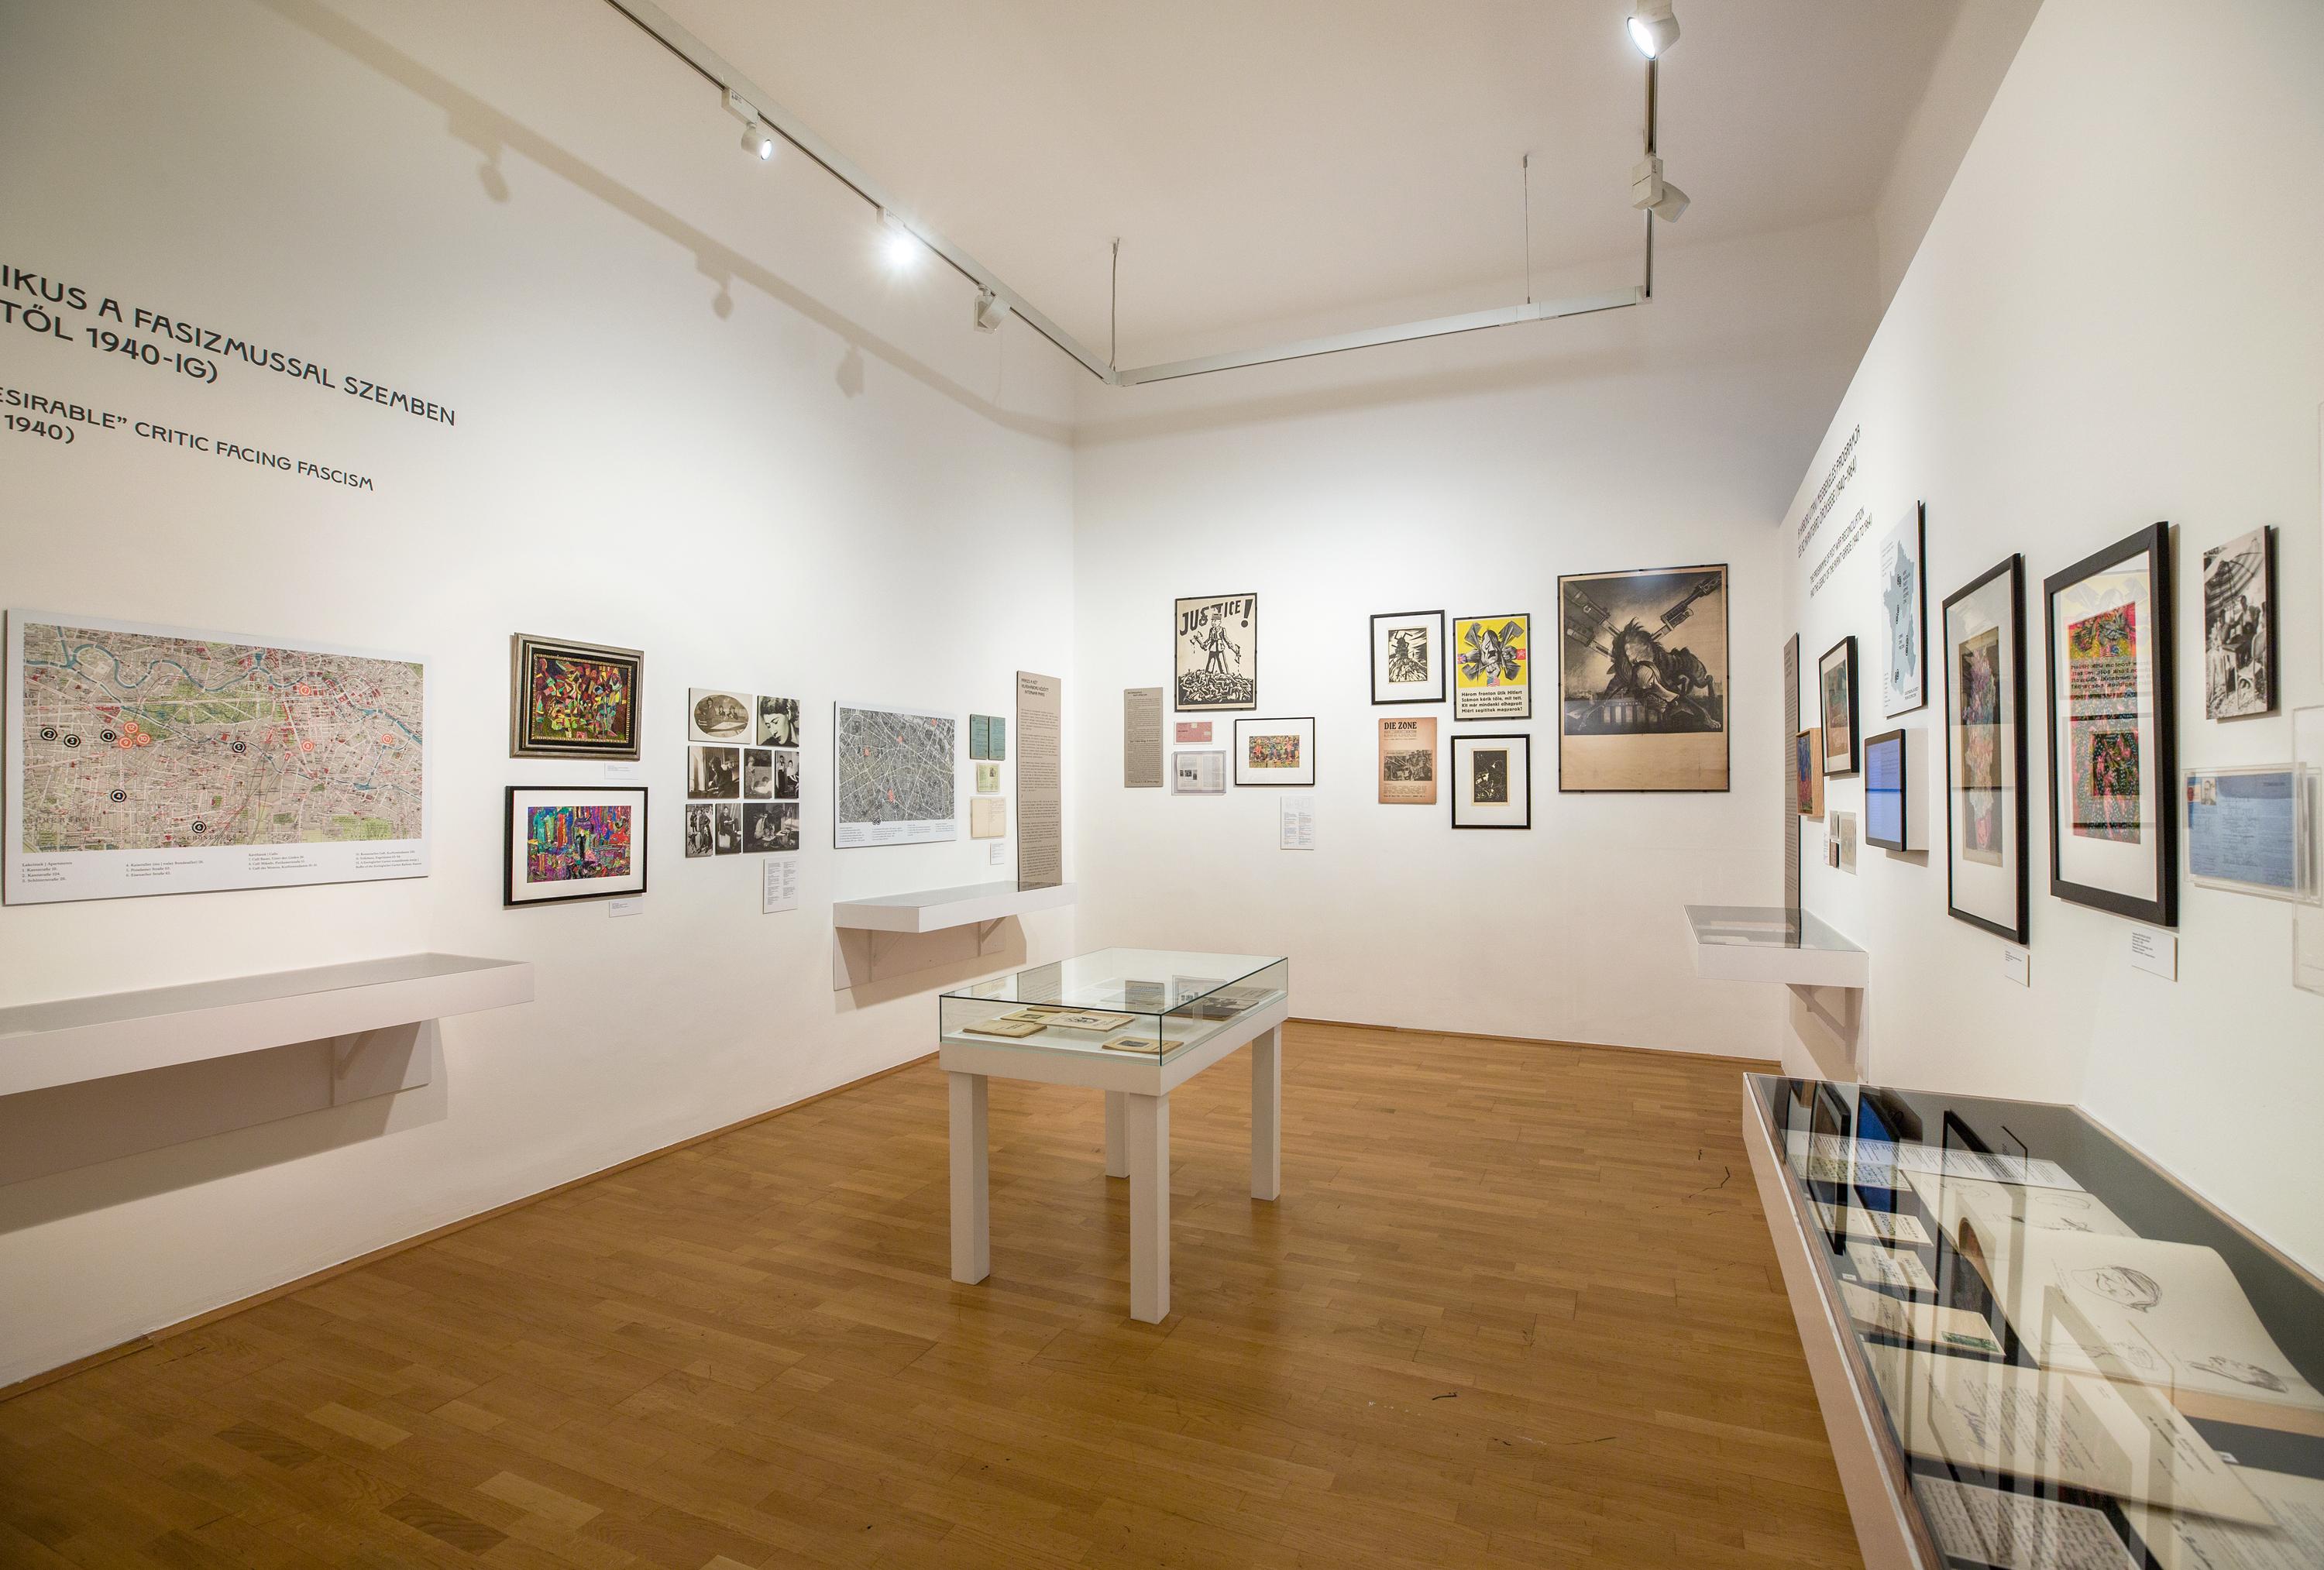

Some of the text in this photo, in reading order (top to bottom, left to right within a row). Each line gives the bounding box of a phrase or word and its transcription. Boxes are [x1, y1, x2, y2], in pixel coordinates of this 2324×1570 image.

[2, 264, 456, 427] IKUS A FASIZMUSSAL SZEMBEN
[85, 327, 218, 384] 1940-IG)
[4, 414, 75, 445] 1940)
[134, 421, 209, 452] CRITIC
[216, 441, 292, 471] FACING
[297, 461, 374, 491] FASCISM
[1397, 721, 1417, 730] ZONE
